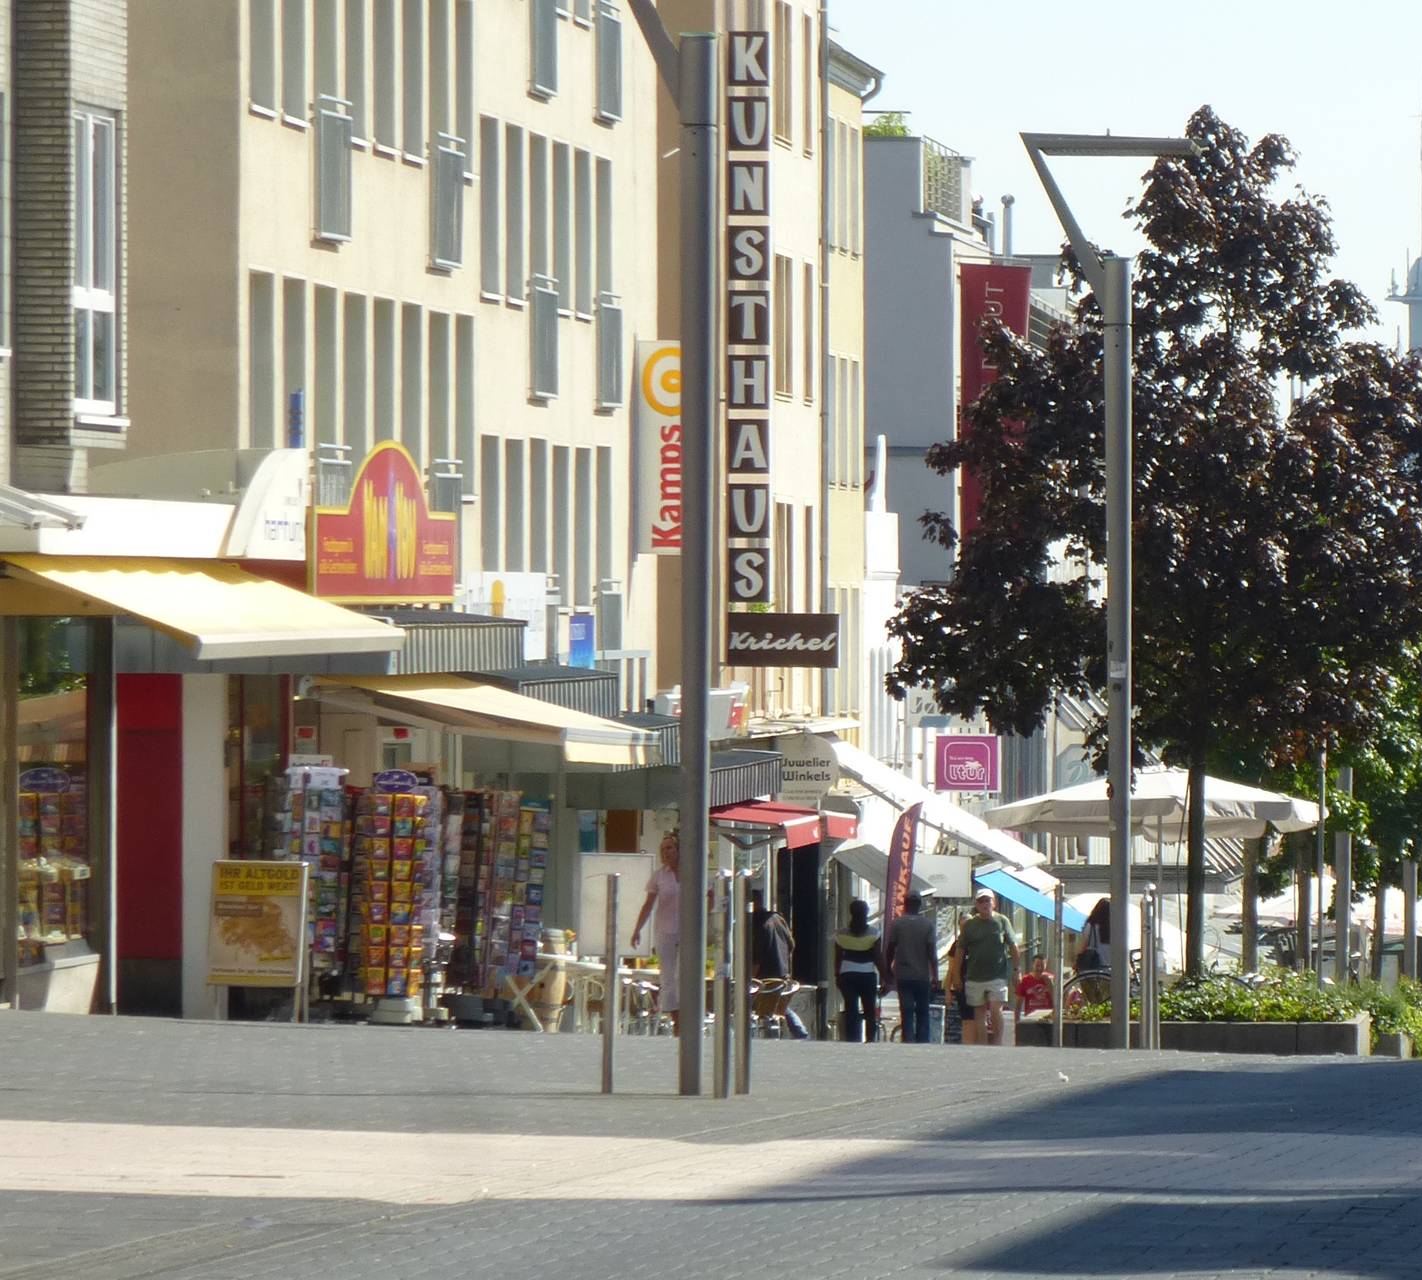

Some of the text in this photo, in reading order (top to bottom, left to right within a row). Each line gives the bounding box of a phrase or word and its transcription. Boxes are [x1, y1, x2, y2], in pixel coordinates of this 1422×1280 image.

[732, 35, 768, 598] KUNSTHAUS
[652, 424, 682, 549] Kamps
[729, 631, 838, 651] Krichel
[782, 757, 831, 767] Juwelier
[783, 771, 831, 781] Winkels
[220, 868, 299, 880] IHR ALTGOLD
